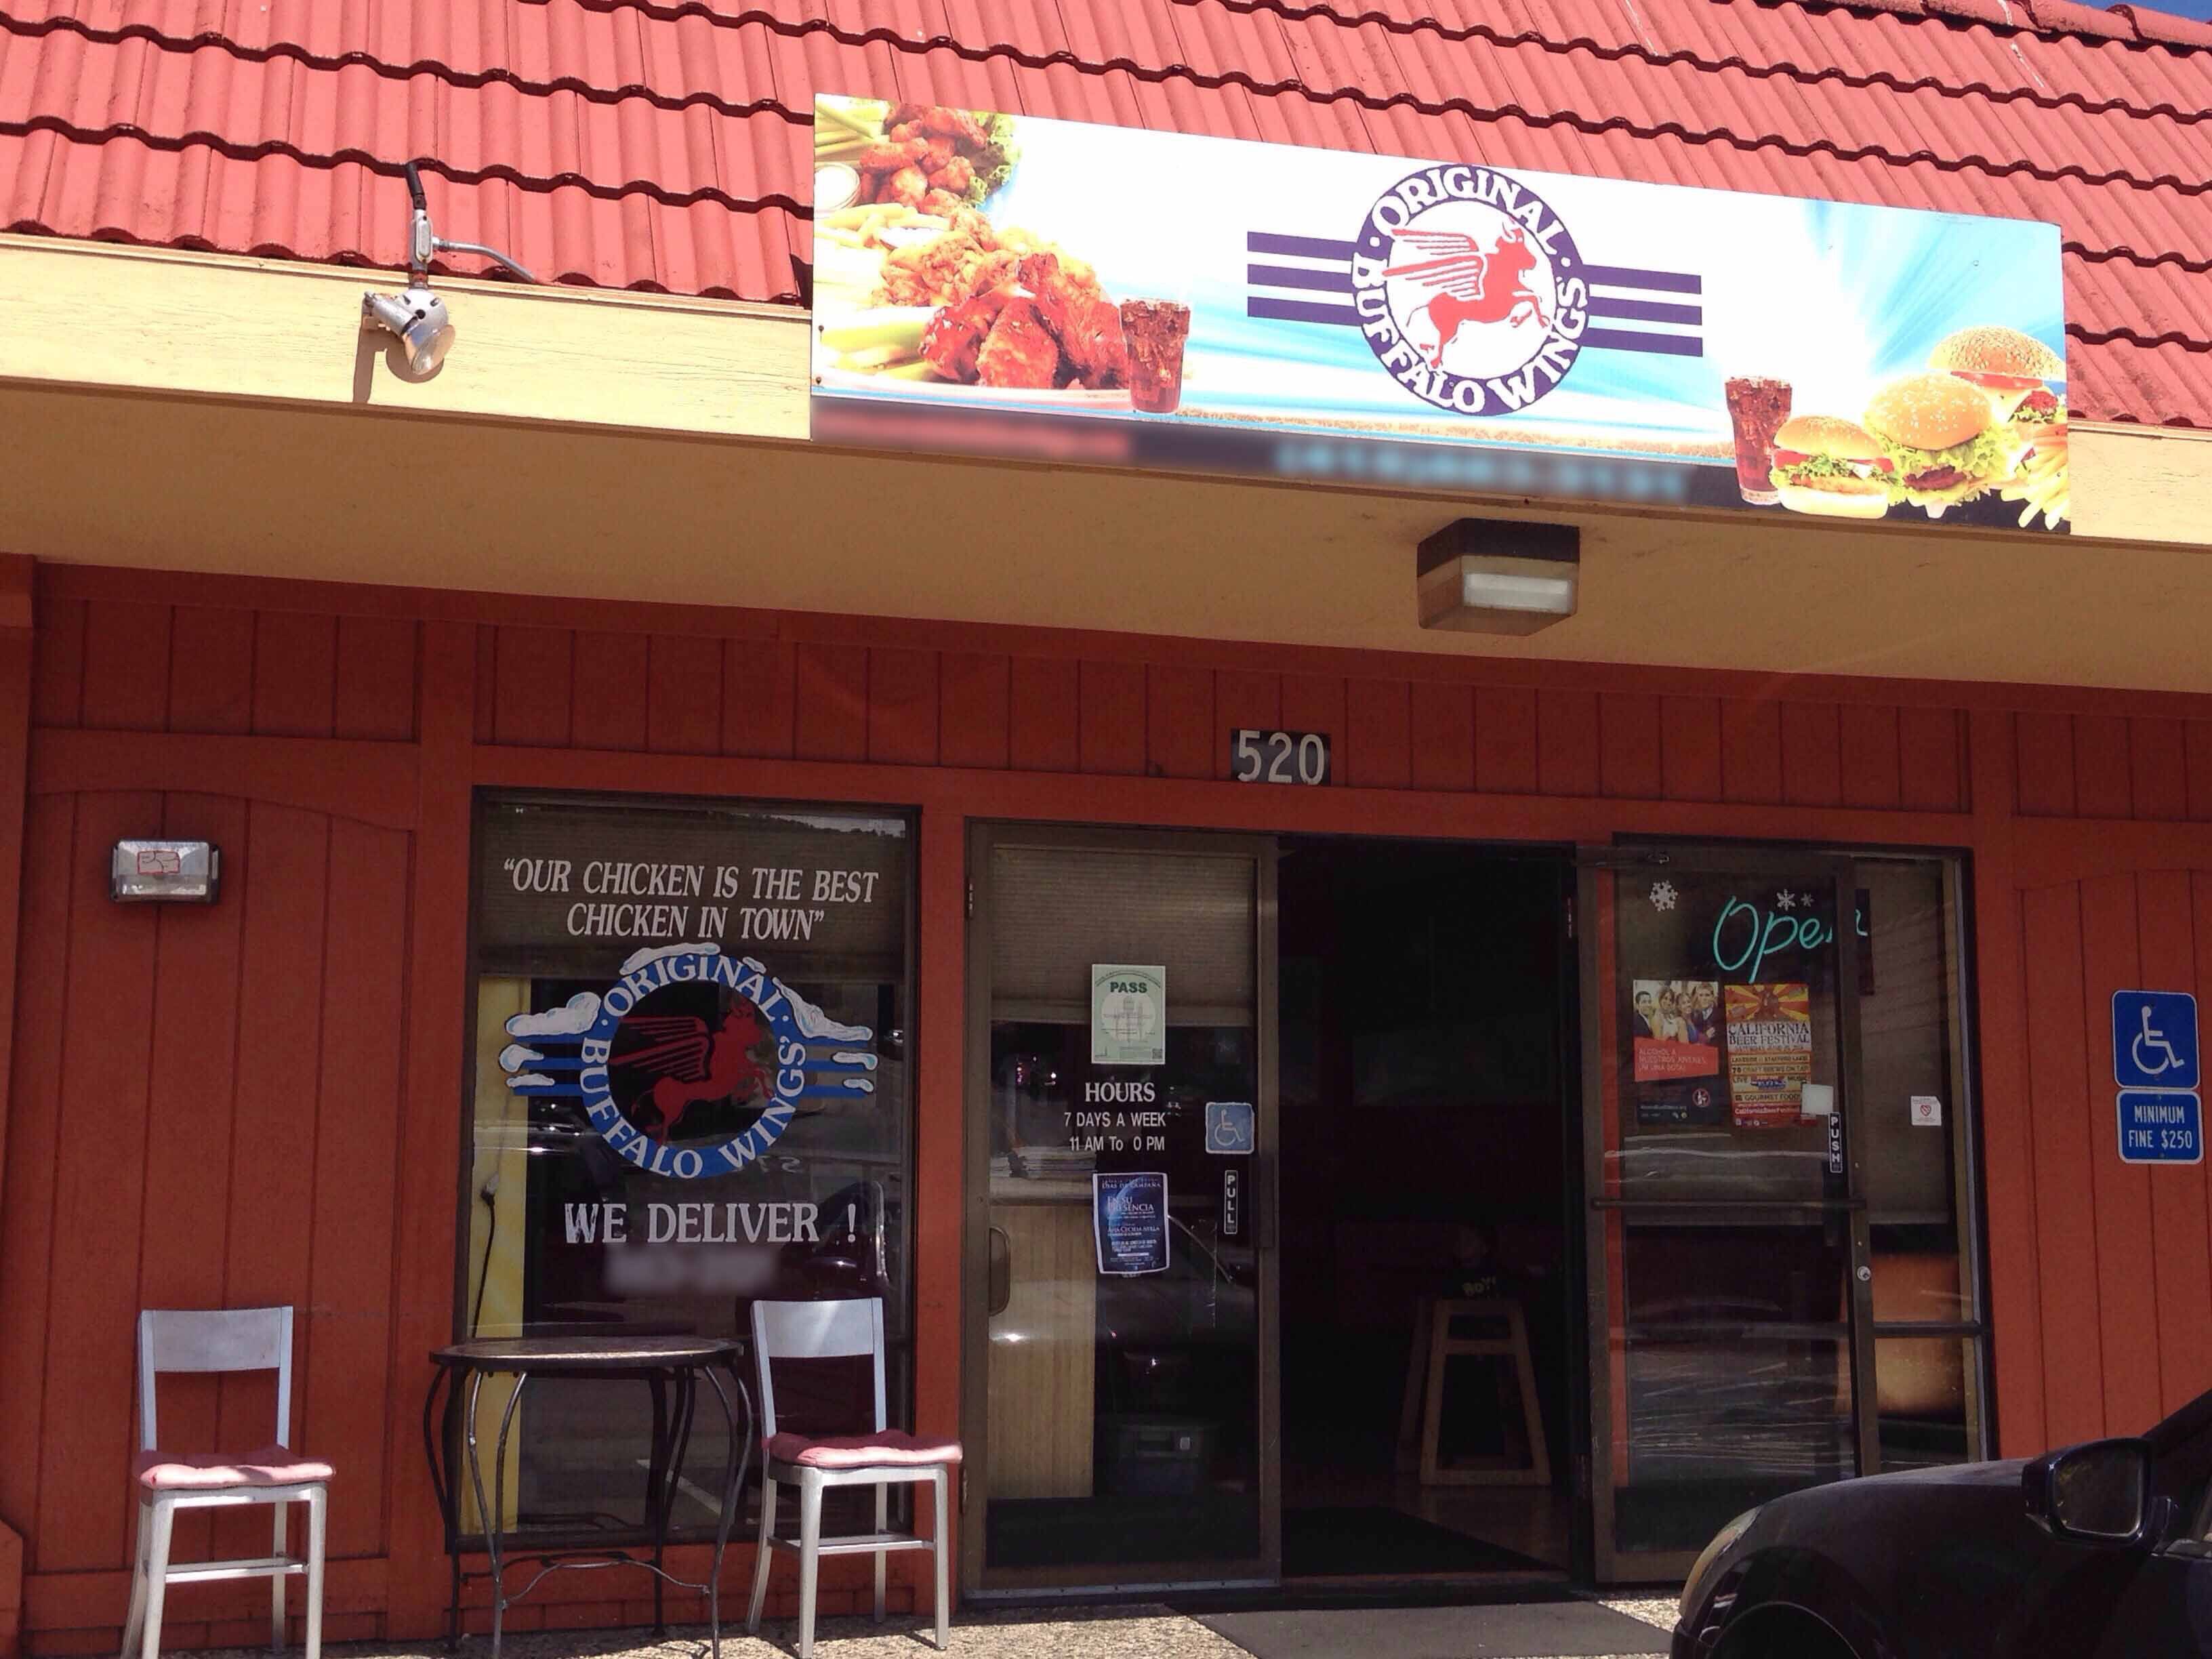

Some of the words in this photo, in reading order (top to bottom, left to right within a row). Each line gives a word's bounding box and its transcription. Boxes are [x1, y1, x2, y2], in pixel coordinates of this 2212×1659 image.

[1372, 166, 1564, 255] ORIGINAL
[1352, 252, 1486, 414] BUFFALO
[1237, 729, 1325, 785] 520
[583, 861, 705, 897] CHICKEN
[713, 865, 739, 899] IS
[752, 867, 803, 901] THE
[813, 870, 880, 903] BEST
[567, 902, 689, 938] CHICKEN
[698, 906, 729, 938] IN
[602, 954, 777, 1021] ORIGINAL
[1109, 981, 1148, 994] PASS
[1728, 1021, 1809, 1036] CALIFORNIA
[1729, 1036, 1757, 1045] BEER
[1761, 1035, 1810, 1045] FESTIVAL
[579, 1037, 703, 1179] BUFFALO
[1085, 1082, 1155, 1103] HOURS
[1064, 1111, 1072, 1128] 7
[1076, 1111, 1111, 1128] DAYS
[1115, 1112, 1126, 1127] A
[1130, 1112, 1166, 1128] WEEK
[2134, 1105, 2185, 1124] MINIMUM
[1069, 1136, 1080, 1151] 11
[1084, 1136, 1105, 1151] AM
[1147, 1136, 1165, 1151] PM
[1830, 1116, 1841, 1162] PUSH
[2128, 1130, 2154, 1149] FINE
[2160, 1128, 2193, 1150] $250
[1226, 1174, 1236, 1224] PULL
[564, 1202, 627, 1244] WE
[647, 1202, 820, 1244] DELIVER
